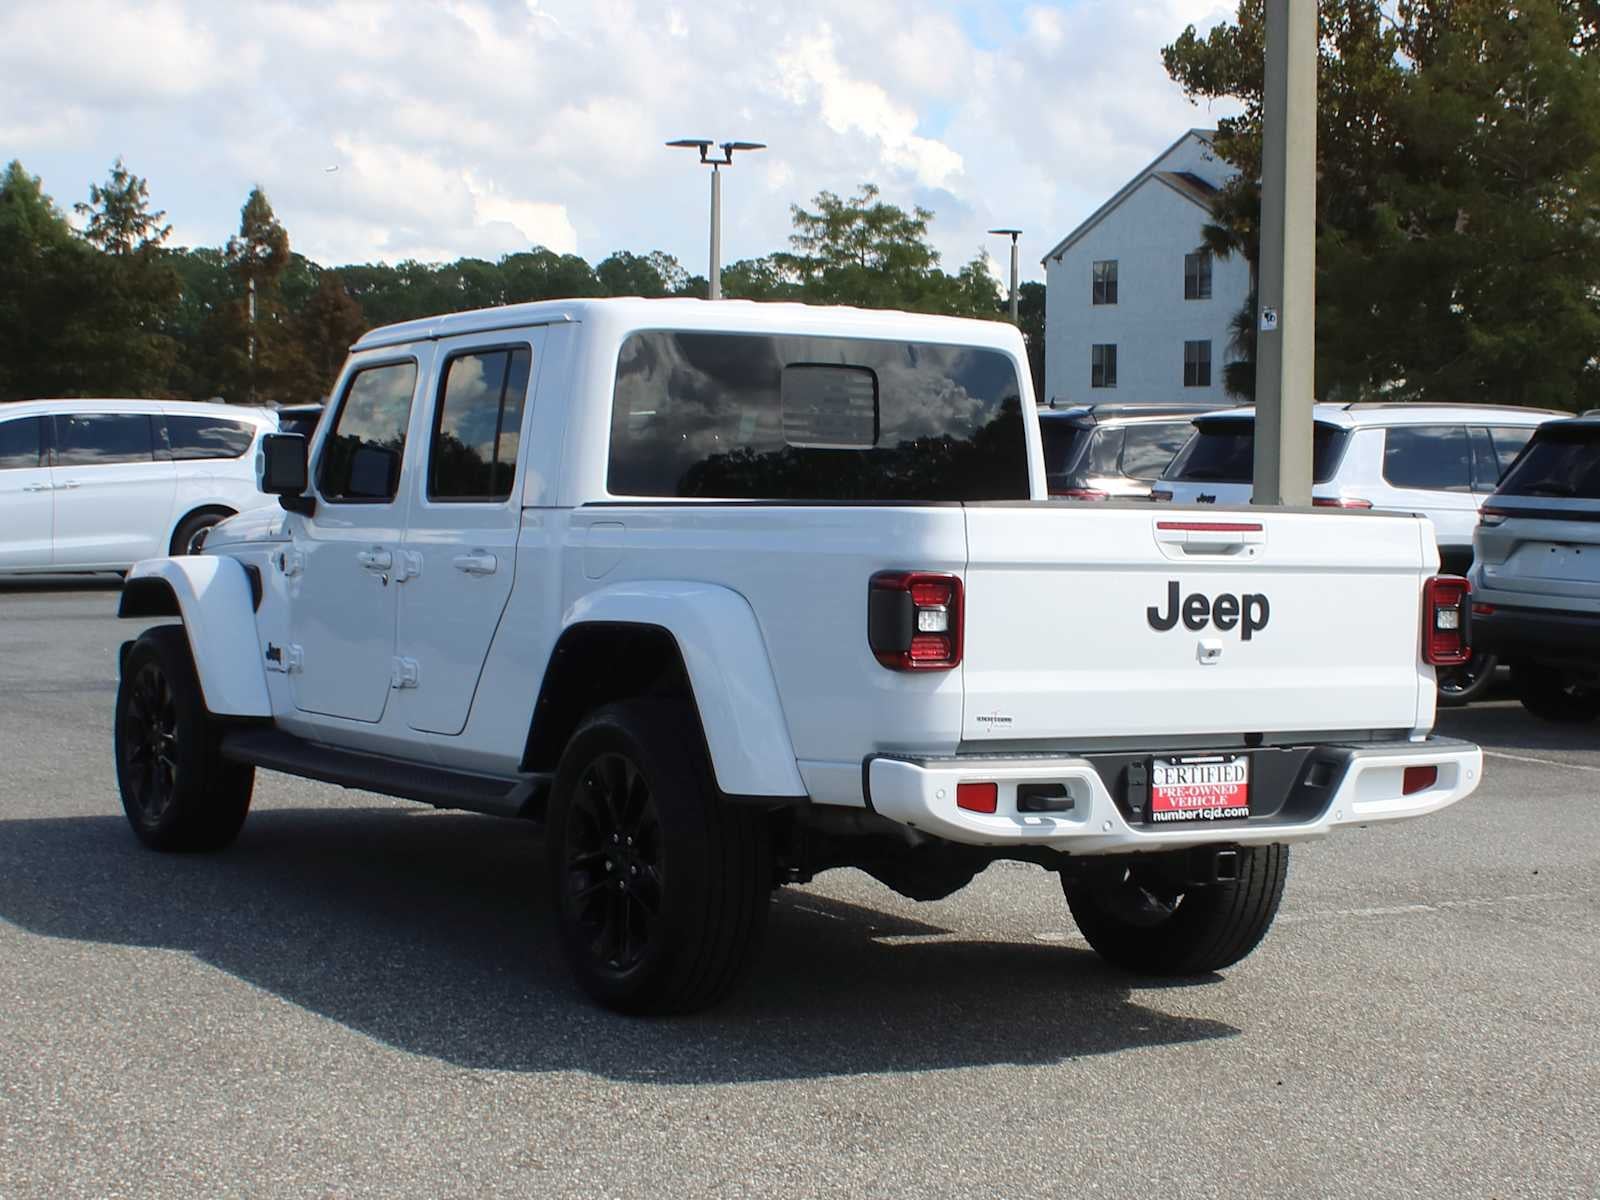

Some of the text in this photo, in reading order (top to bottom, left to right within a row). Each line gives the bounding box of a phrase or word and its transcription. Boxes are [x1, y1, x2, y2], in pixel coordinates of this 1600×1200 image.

[1146, 580, 1270, 641] Jeep
[1153, 766, 1246, 784] CERTIFIED
[1159, 784, 1238, 798] PRE-OWNED
[1169, 795, 1229, 807] VEHICLE
[1153, 806, 1249, 821] number1cjd.com
